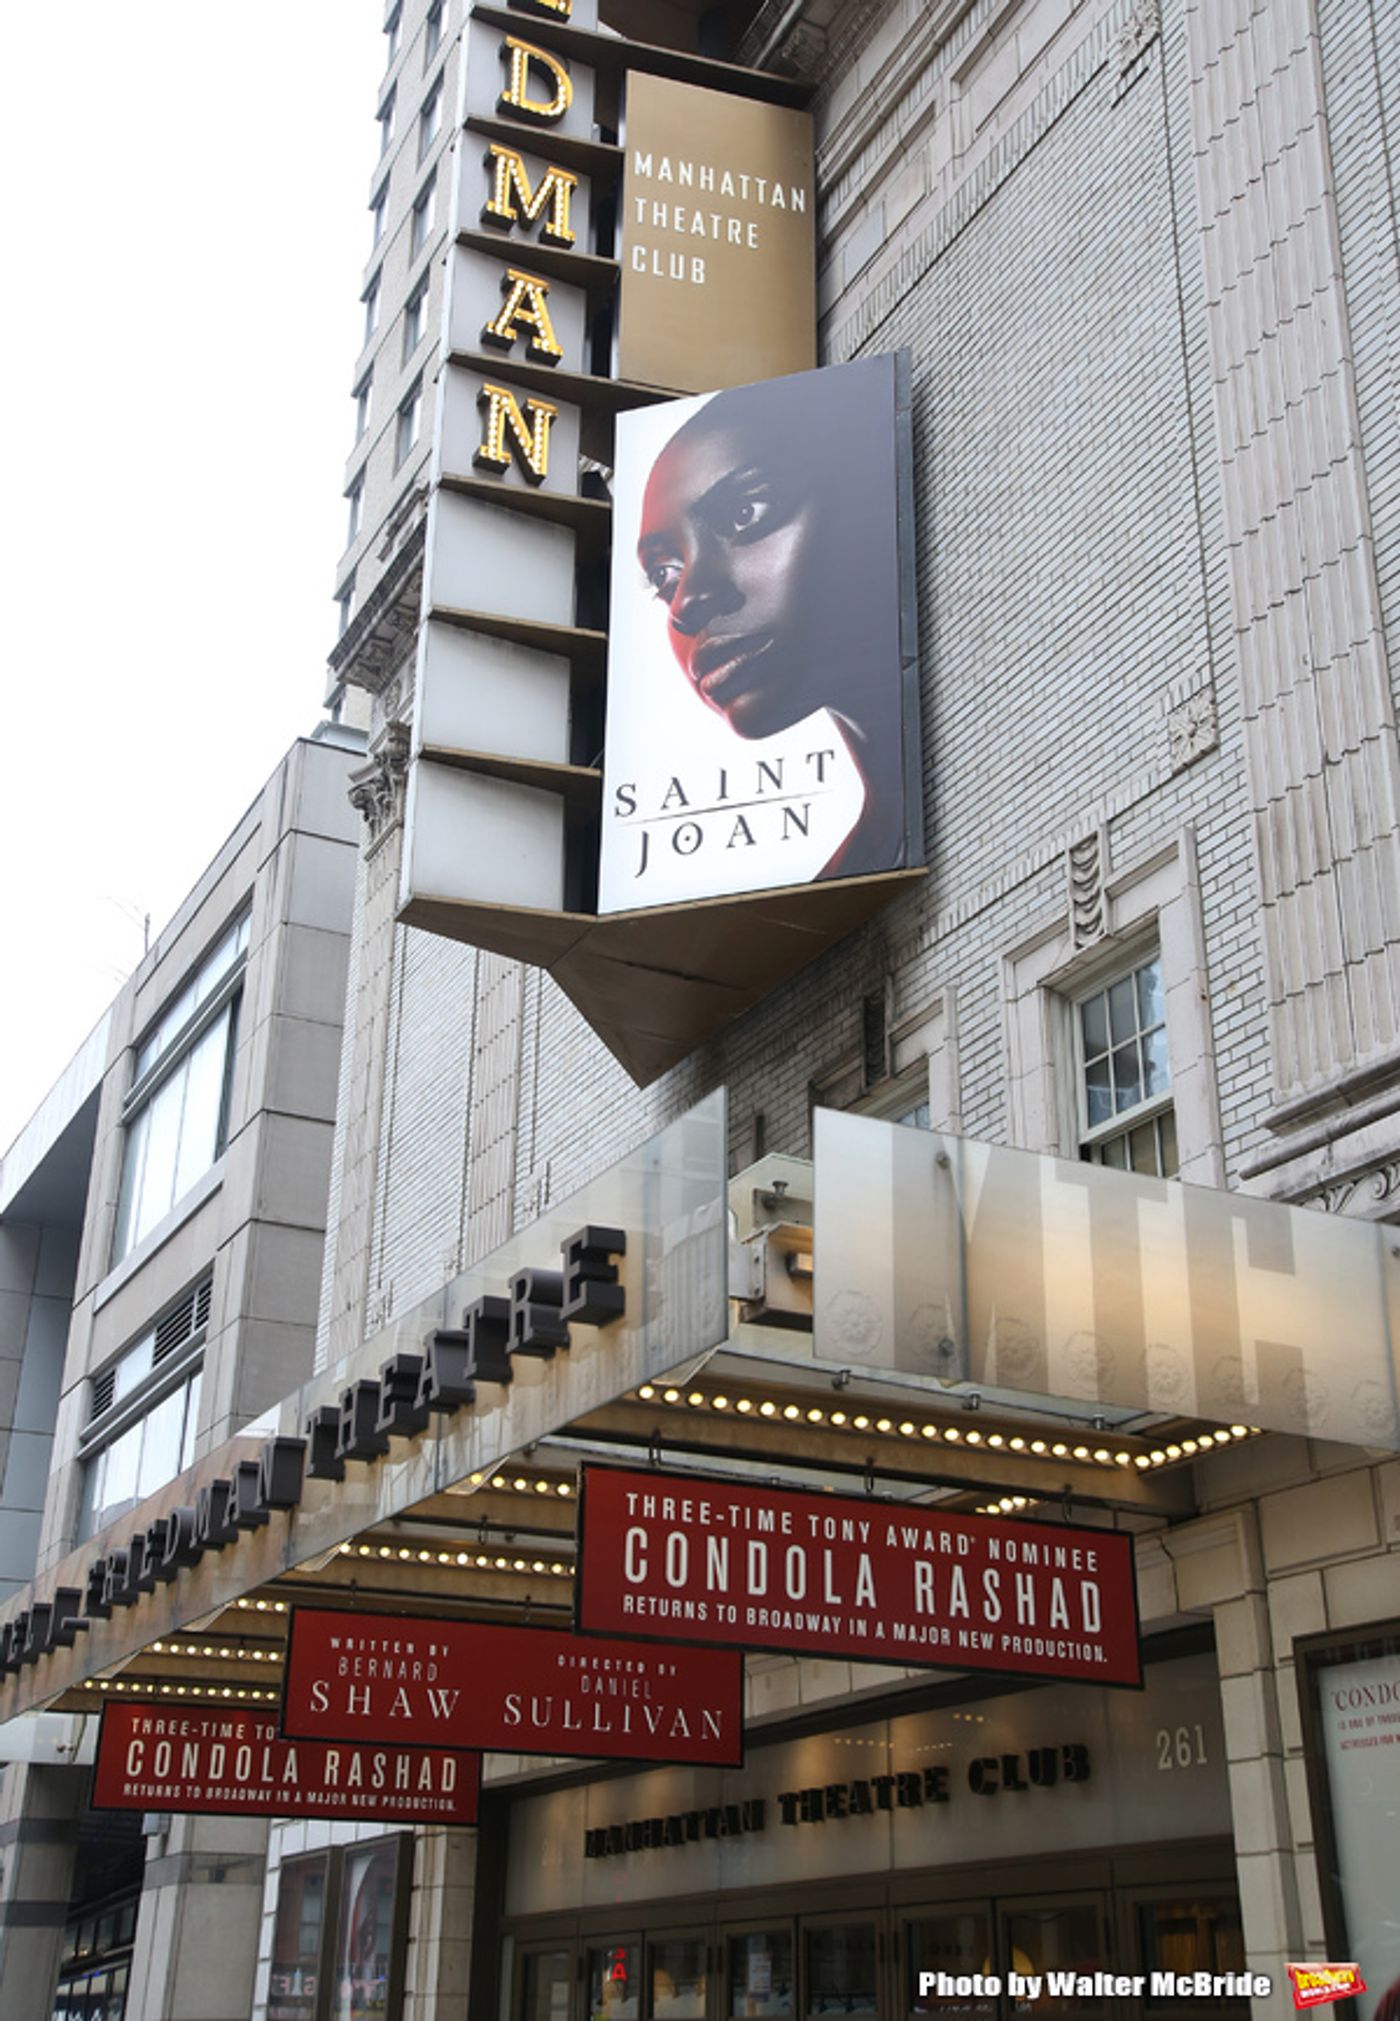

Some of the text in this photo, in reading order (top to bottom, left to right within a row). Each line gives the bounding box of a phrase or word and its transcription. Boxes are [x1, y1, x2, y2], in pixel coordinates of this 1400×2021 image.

[634, 151, 806, 214] MANHATTAN
[472, 0, 578, 486] DMAN
[635, 197, 759, 249] THEATRE
[632, 245, 706, 285] CLUB
[614, 749, 835, 818] SAINT
[635, 803, 811, 878] JOAN
[306, 1225, 627, 1483] THEATRE
[626, 1492, 794, 1535] THREE-TIME
[808, 1514, 871, 1544] TONY
[989, 1538, 1099, 1573] NOMINEE
[624, 1526, 1102, 1634] CONDOLA RASHAD
[331, 1636, 451, 1658] WRITTEN BY
[623, 1594, 1109, 1664] RETURNS TO BROADWAY IN A MAJOR NEW PRODUCTION.
[338, 1656, 439, 1683] BERNARD
[558, 1653, 678, 1677] DIRECTED BY
[581, 1674, 653, 1700] DANIEL
[310, 1679, 461, 1720] SHAW
[503, 1693, 724, 1741] SULLIVAN
[132, 1717, 280, 1741] THREE-TIME TO
[1156, 1723, 1208, 1771] 261
[126, 1739, 457, 1793] CONDOLA RASHAD
[123, 1782, 182, 1799] RETURNS
[187, 1784, 201, 1799] TO
[206, 1785, 272, 1802] BROADWAY
[277, 1788, 290, 1803] IN
[294, 1790, 302, 1803] A
[307, 1791, 348, 1806] MAJOR
[352, 1794, 377, 1808] NEW
[584, 1799, 767, 1859] MANHATTAN
[777, 1765, 951, 1826] THEATRE
[967, 1742, 1092, 1796] CLUB
